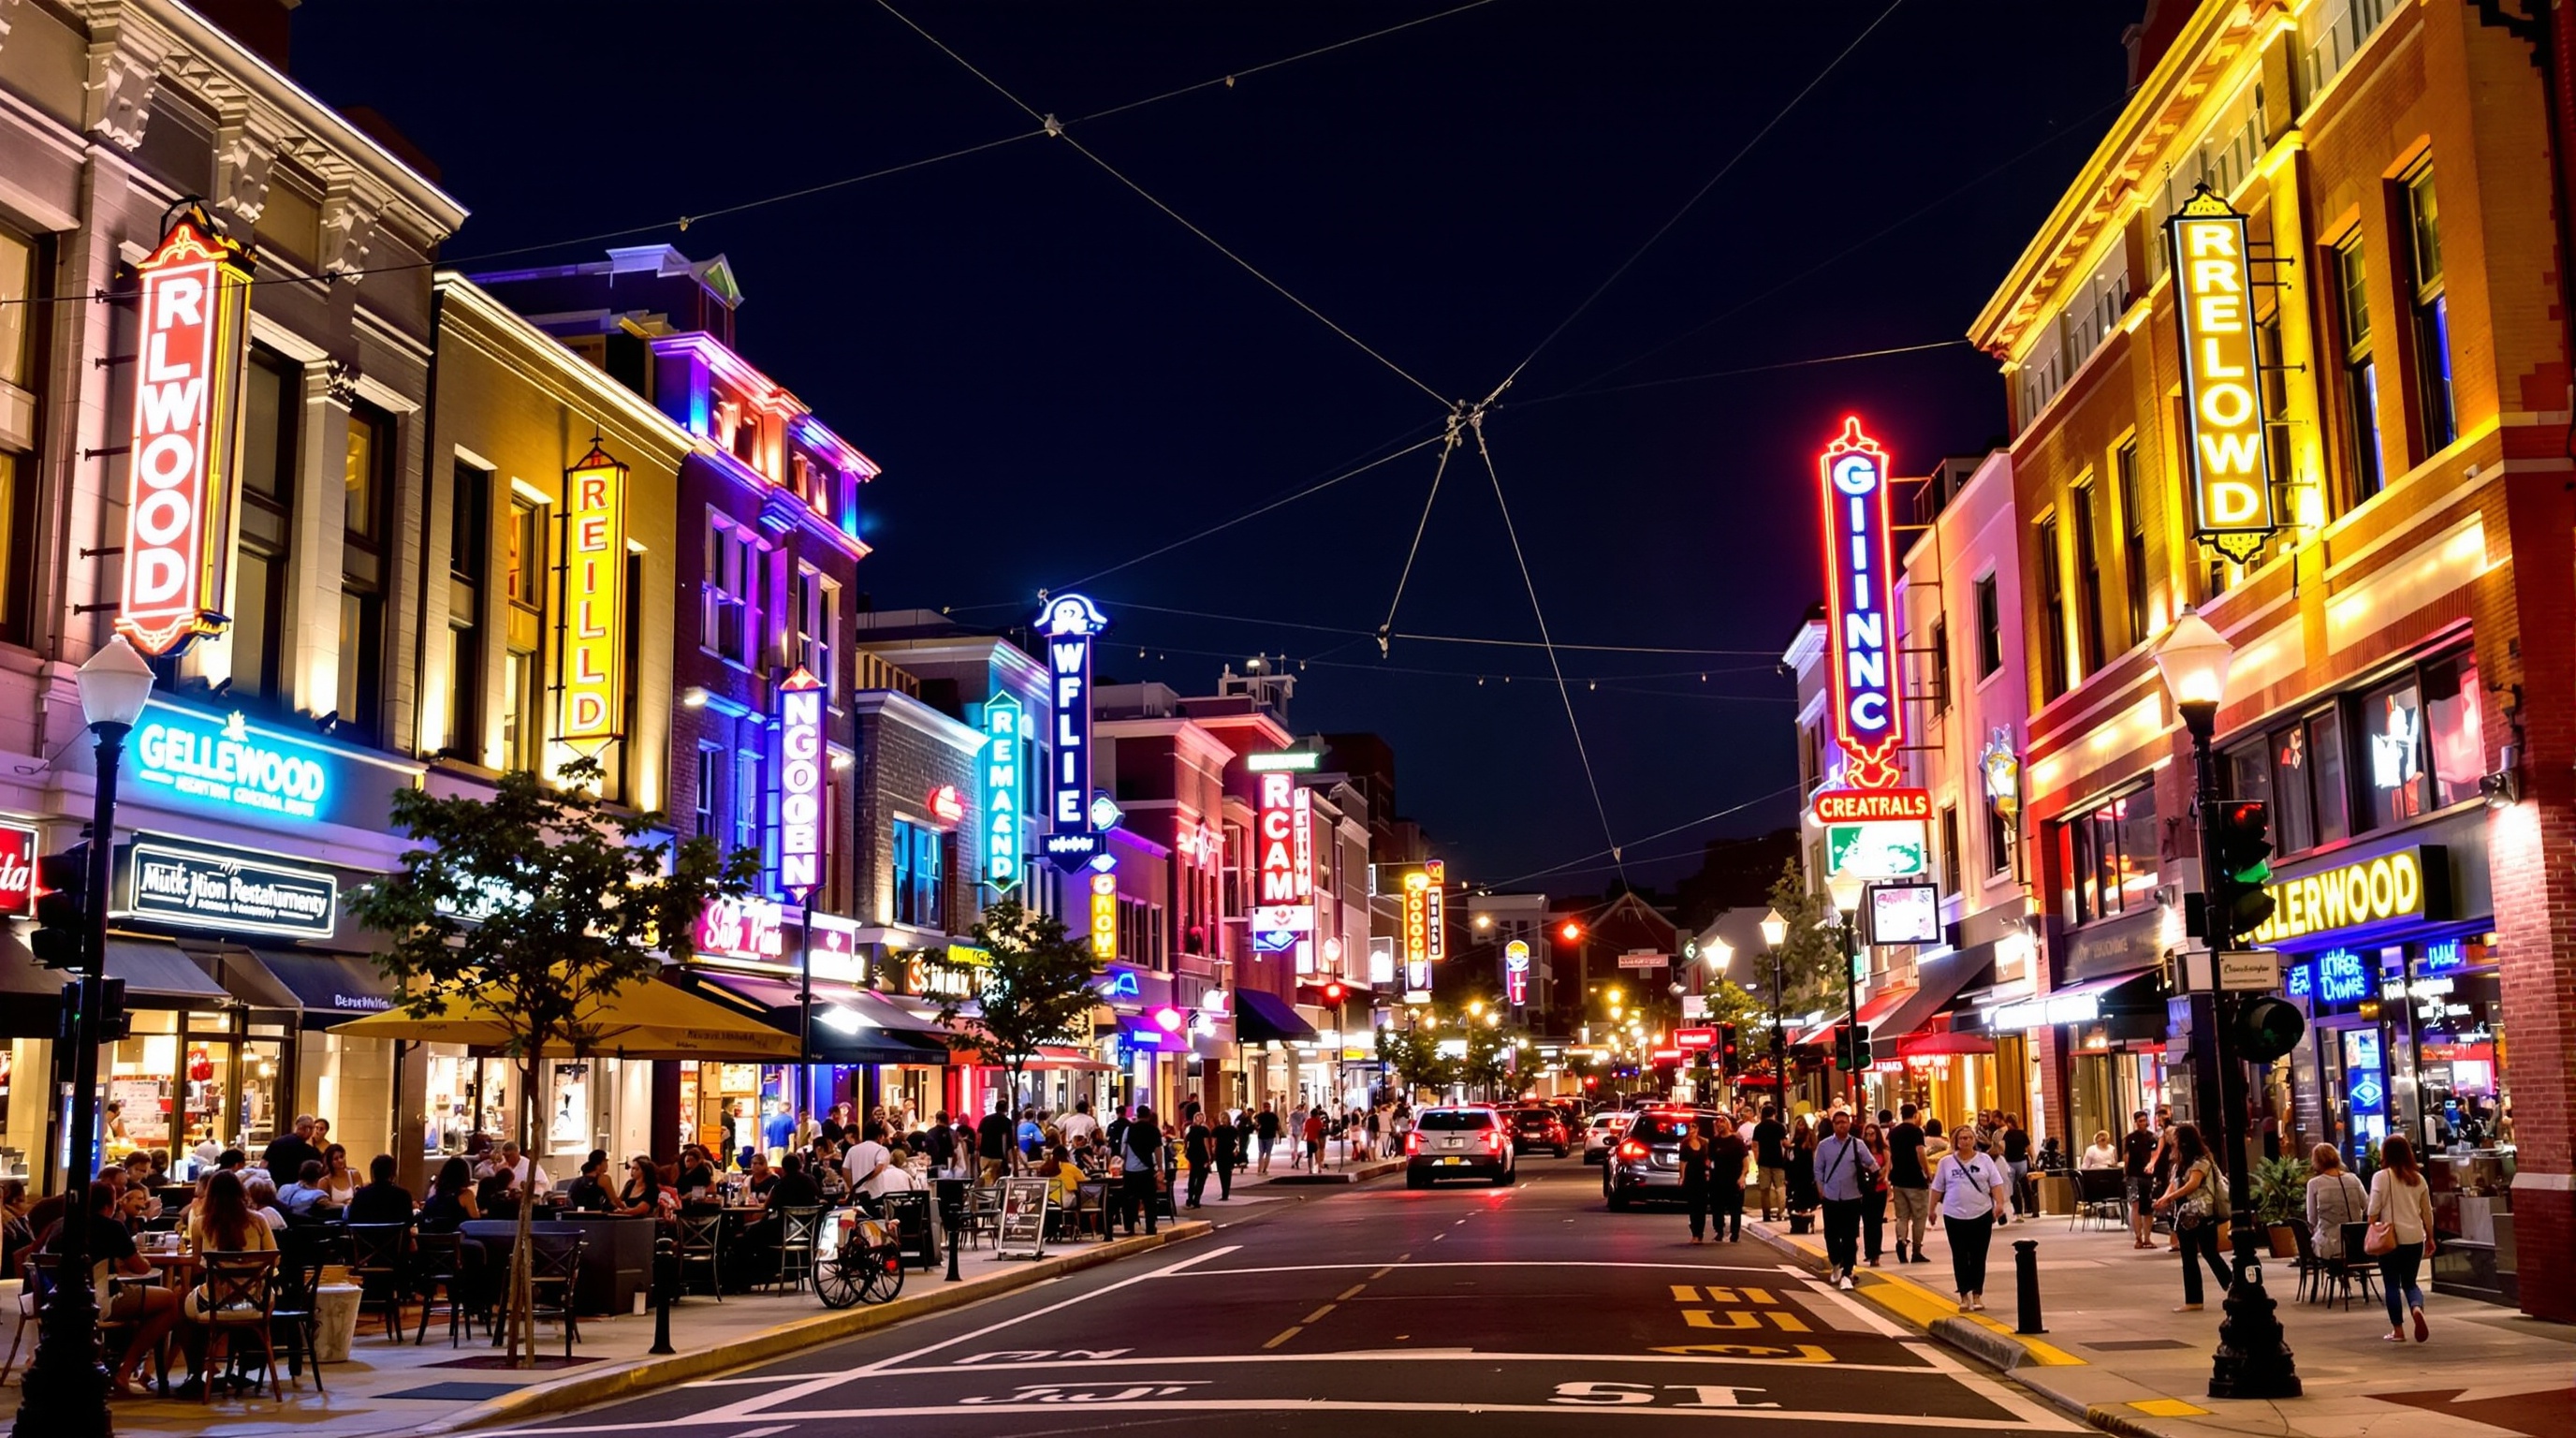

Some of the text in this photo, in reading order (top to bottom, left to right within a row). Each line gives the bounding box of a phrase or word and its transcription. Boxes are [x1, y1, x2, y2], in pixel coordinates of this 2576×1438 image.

[133, 277, 203, 605] RLWOOD
[2188, 224, 2261, 524] RRELOWD
[571, 475, 610, 732] REILLD
[139, 724, 325, 801] GELLEWOOD
[1819, 796, 1927, 817] CREATRALS
